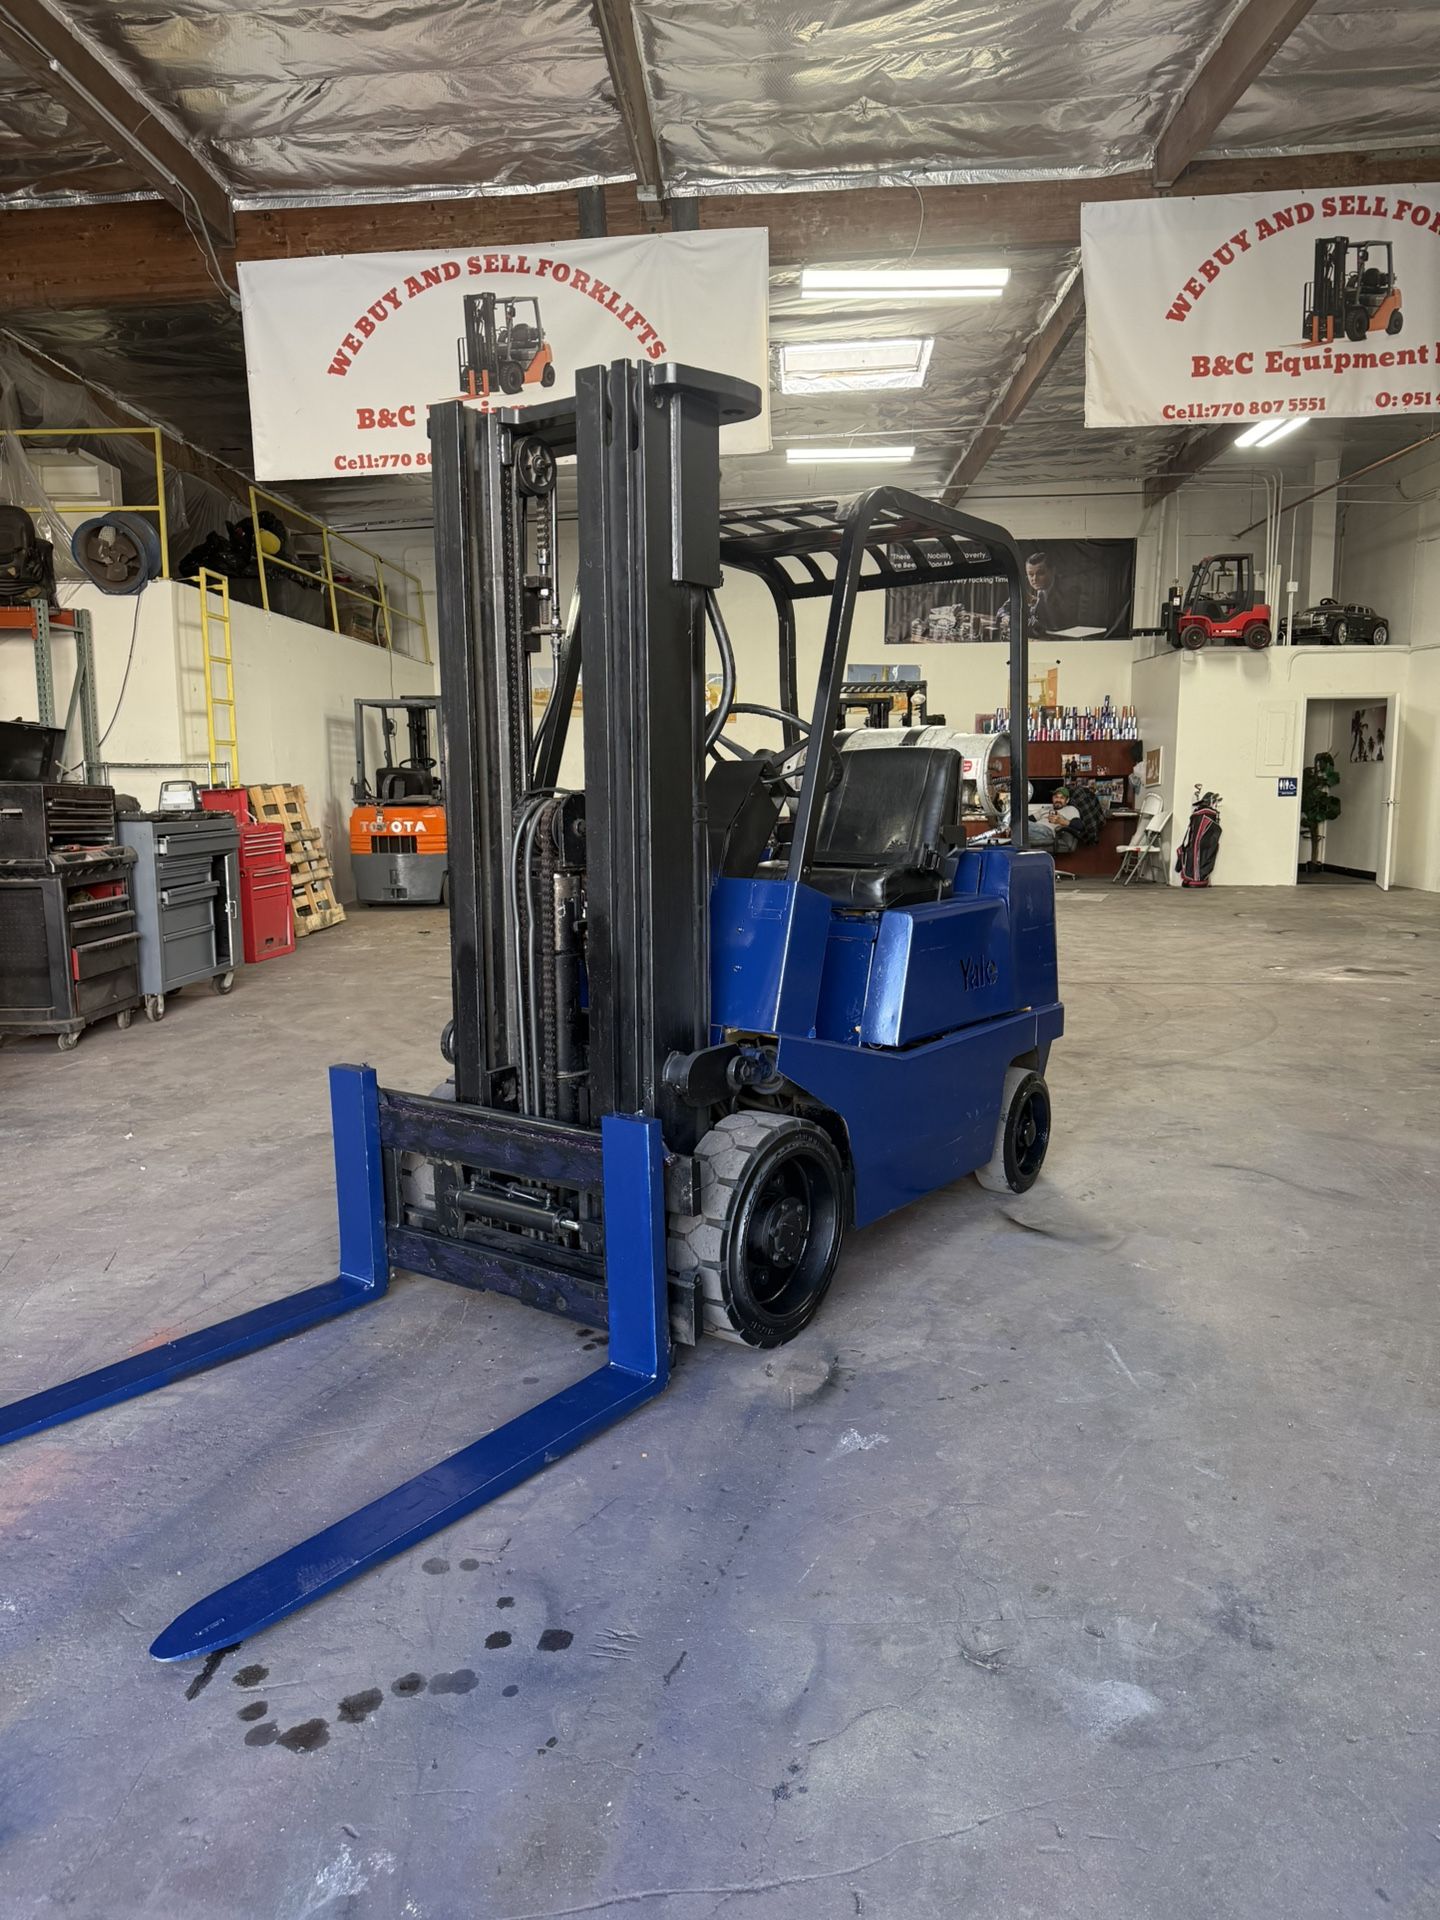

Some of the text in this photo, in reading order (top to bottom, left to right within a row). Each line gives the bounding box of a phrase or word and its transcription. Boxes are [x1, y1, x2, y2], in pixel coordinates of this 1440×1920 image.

[1165, 278, 1206, 323] WE
[1198, 230, 1252, 284] BUY
[1256, 203, 1315, 241] AND
[1321, 195, 1390, 218] SELL
[327, 254, 667, 377] WE BUY AND SELL FORKLIFTS
[1190, 352, 1255, 379] B&C
[1264, 344, 1429, 378] Equipment
[356, 404, 416, 430] B&C
[1248, 399, 1283, 415] 807
[1288, 397, 1327, 412] 5551
[1374, 391, 1398, 408] O:
[1400, 391, 1432, 408] 951
[959, 954, 999, 992] Yale
